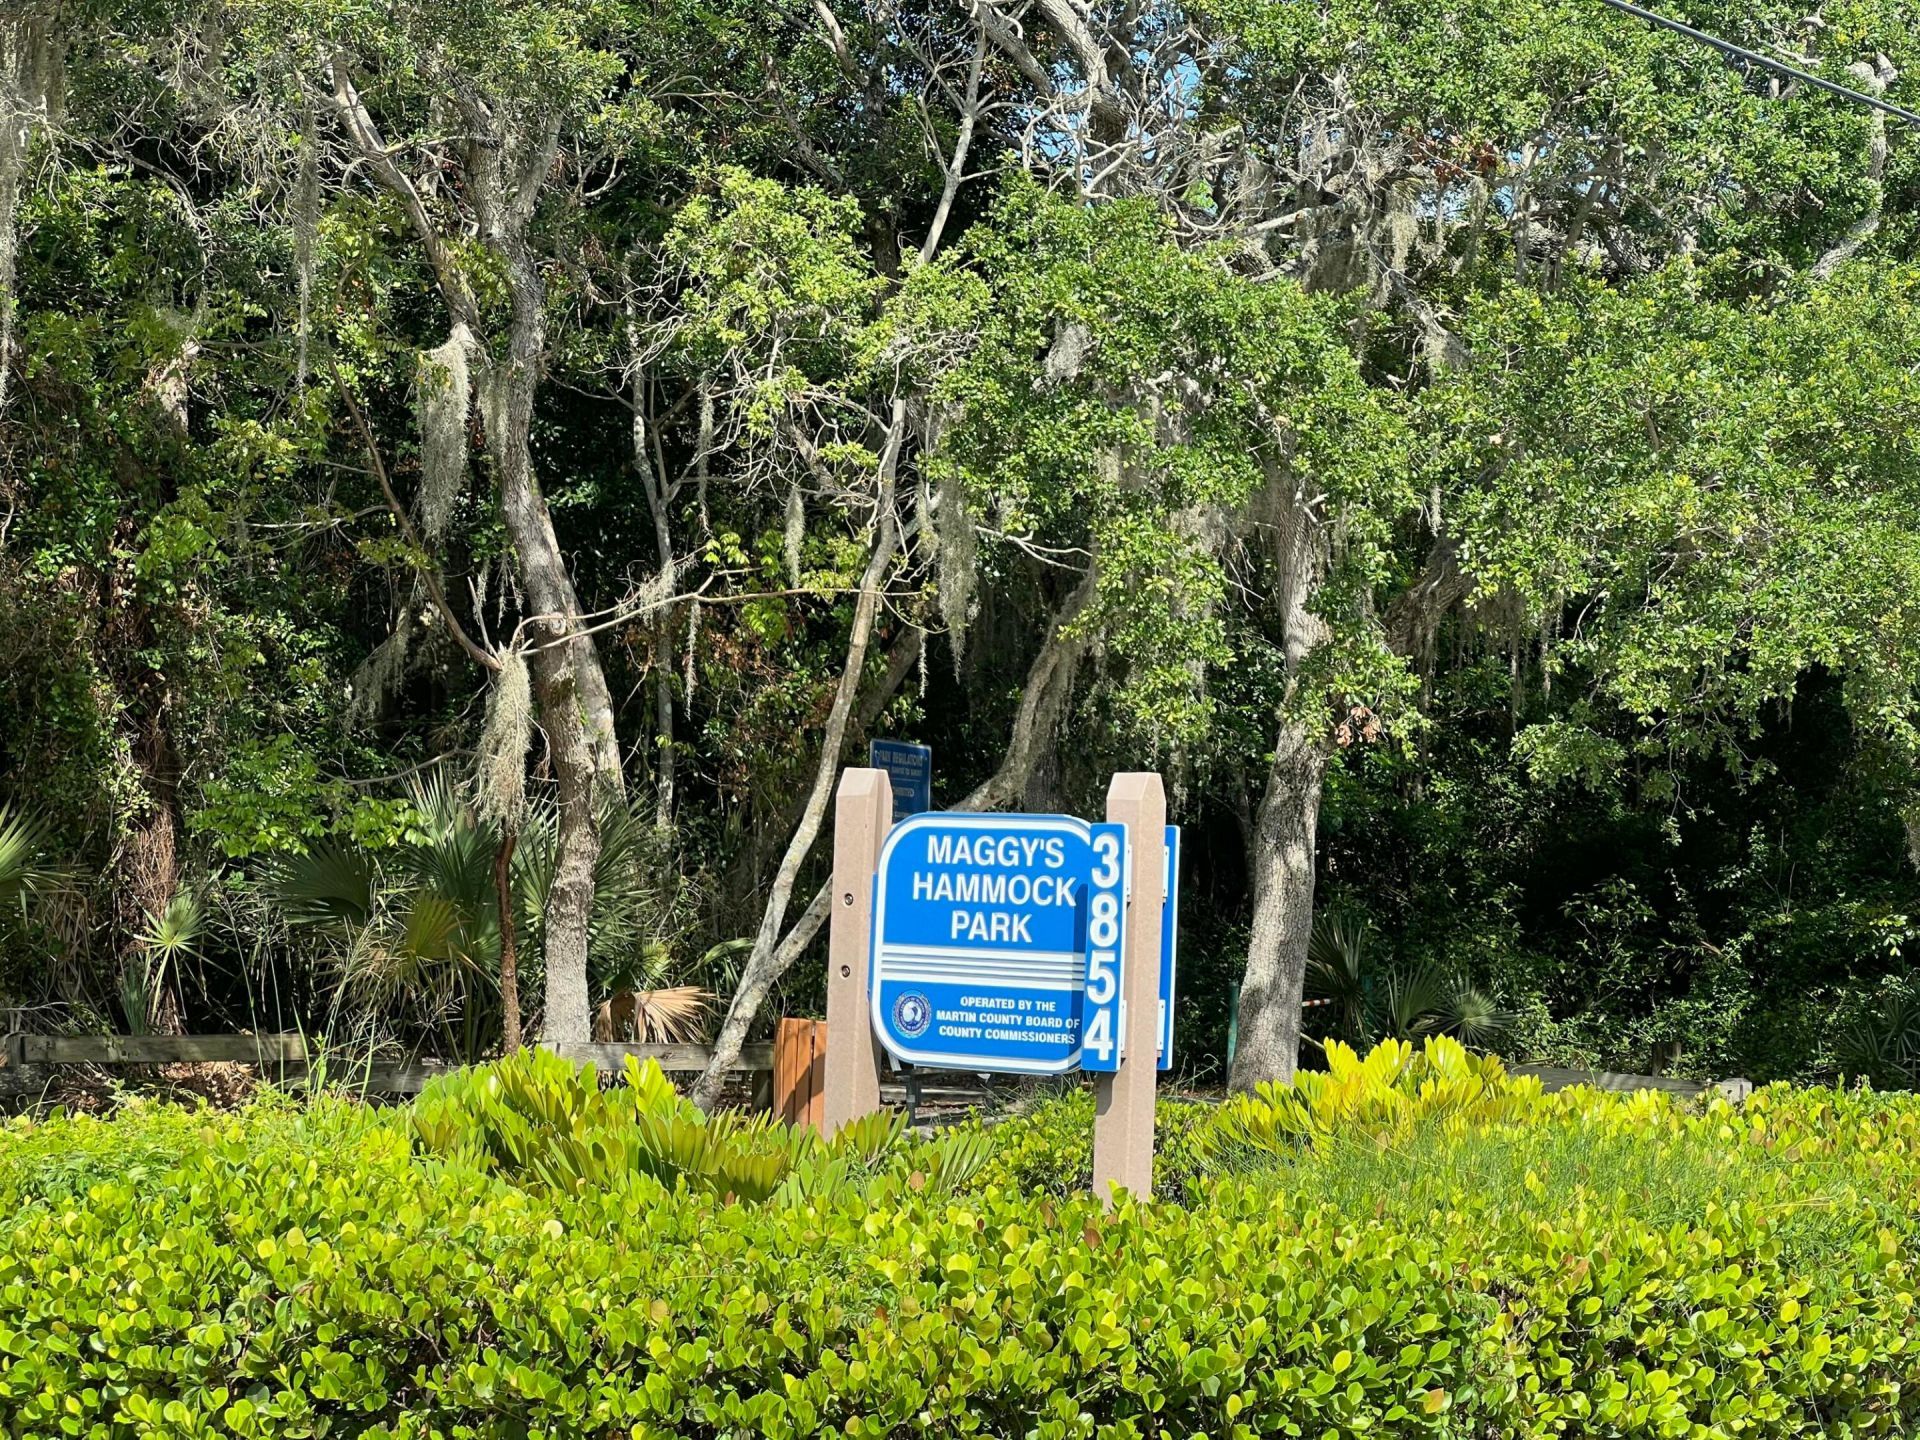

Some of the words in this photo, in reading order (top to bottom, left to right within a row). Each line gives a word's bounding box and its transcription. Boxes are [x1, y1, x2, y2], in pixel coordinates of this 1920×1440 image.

[927, 835, 1065, 868] MAGGY'S
[912, 872, 1076, 907] HAMMOCK
[951, 911, 1032, 943] PARK
[1083, 833, 1120, 1062] 3854
[936, 1010, 976, 1023] MARTIN
[979, 1013, 1022, 1026] COUNTY
[1025, 1015, 1063, 1027] BOARD
[1065, 1018, 1080, 1029] OF
[960, 996, 1015, 1010] OPERATED
[1018, 1000, 1032, 1011] BY
[1035, 1001, 1056, 1012] THE
[939, 1025, 982, 1039] COUNTY
[984, 1028, 1076, 1045] COMMISSIONERS
